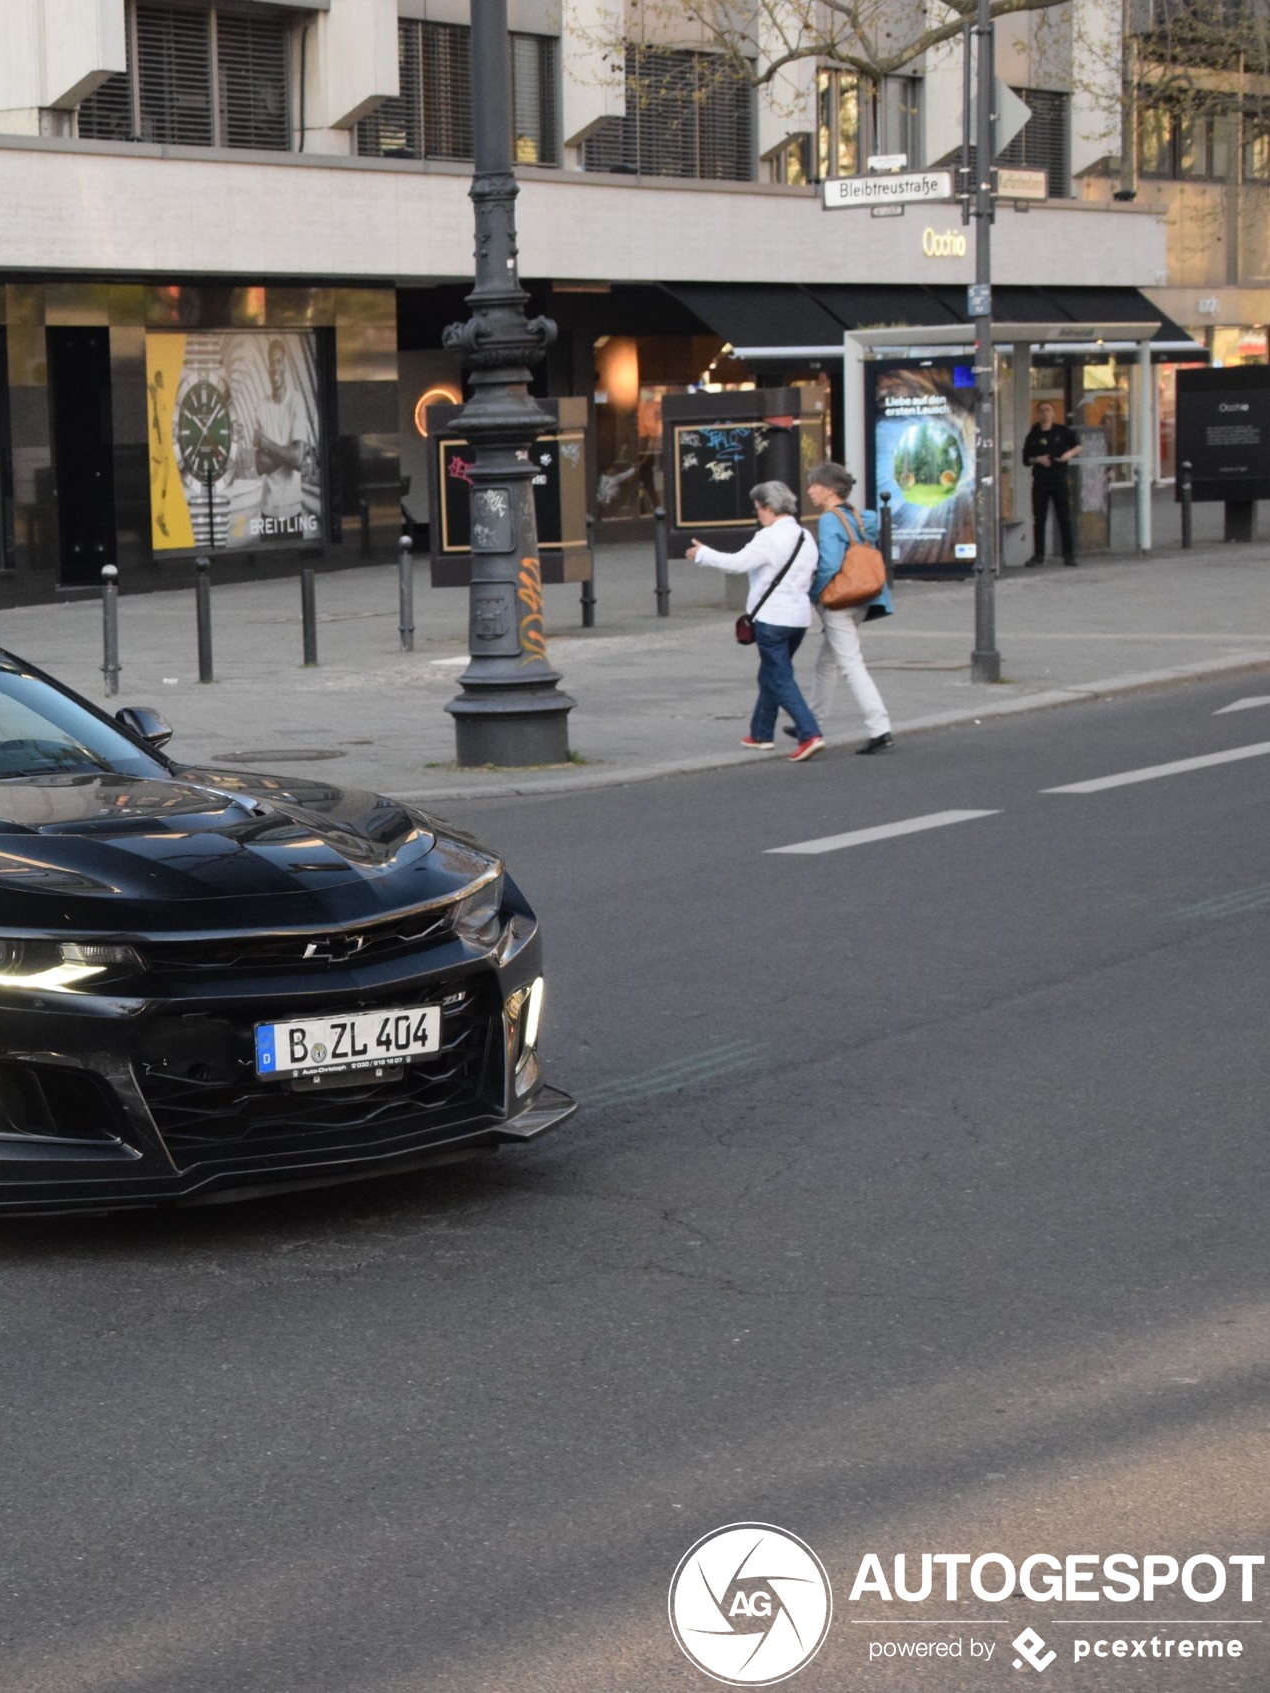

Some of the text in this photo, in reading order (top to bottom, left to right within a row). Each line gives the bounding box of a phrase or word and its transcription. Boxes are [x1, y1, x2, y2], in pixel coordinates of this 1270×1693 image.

[839, 176, 938, 198] Bleibtreustraße
[885, 395, 947, 407] Liebe auf den
[885, 406, 915, 417] ersten
[250, 514, 318, 535] BREITLING
[289, 1012, 429, 1064] B ZL 404
[302, 1064, 347, 1076] Auto-Christoph
